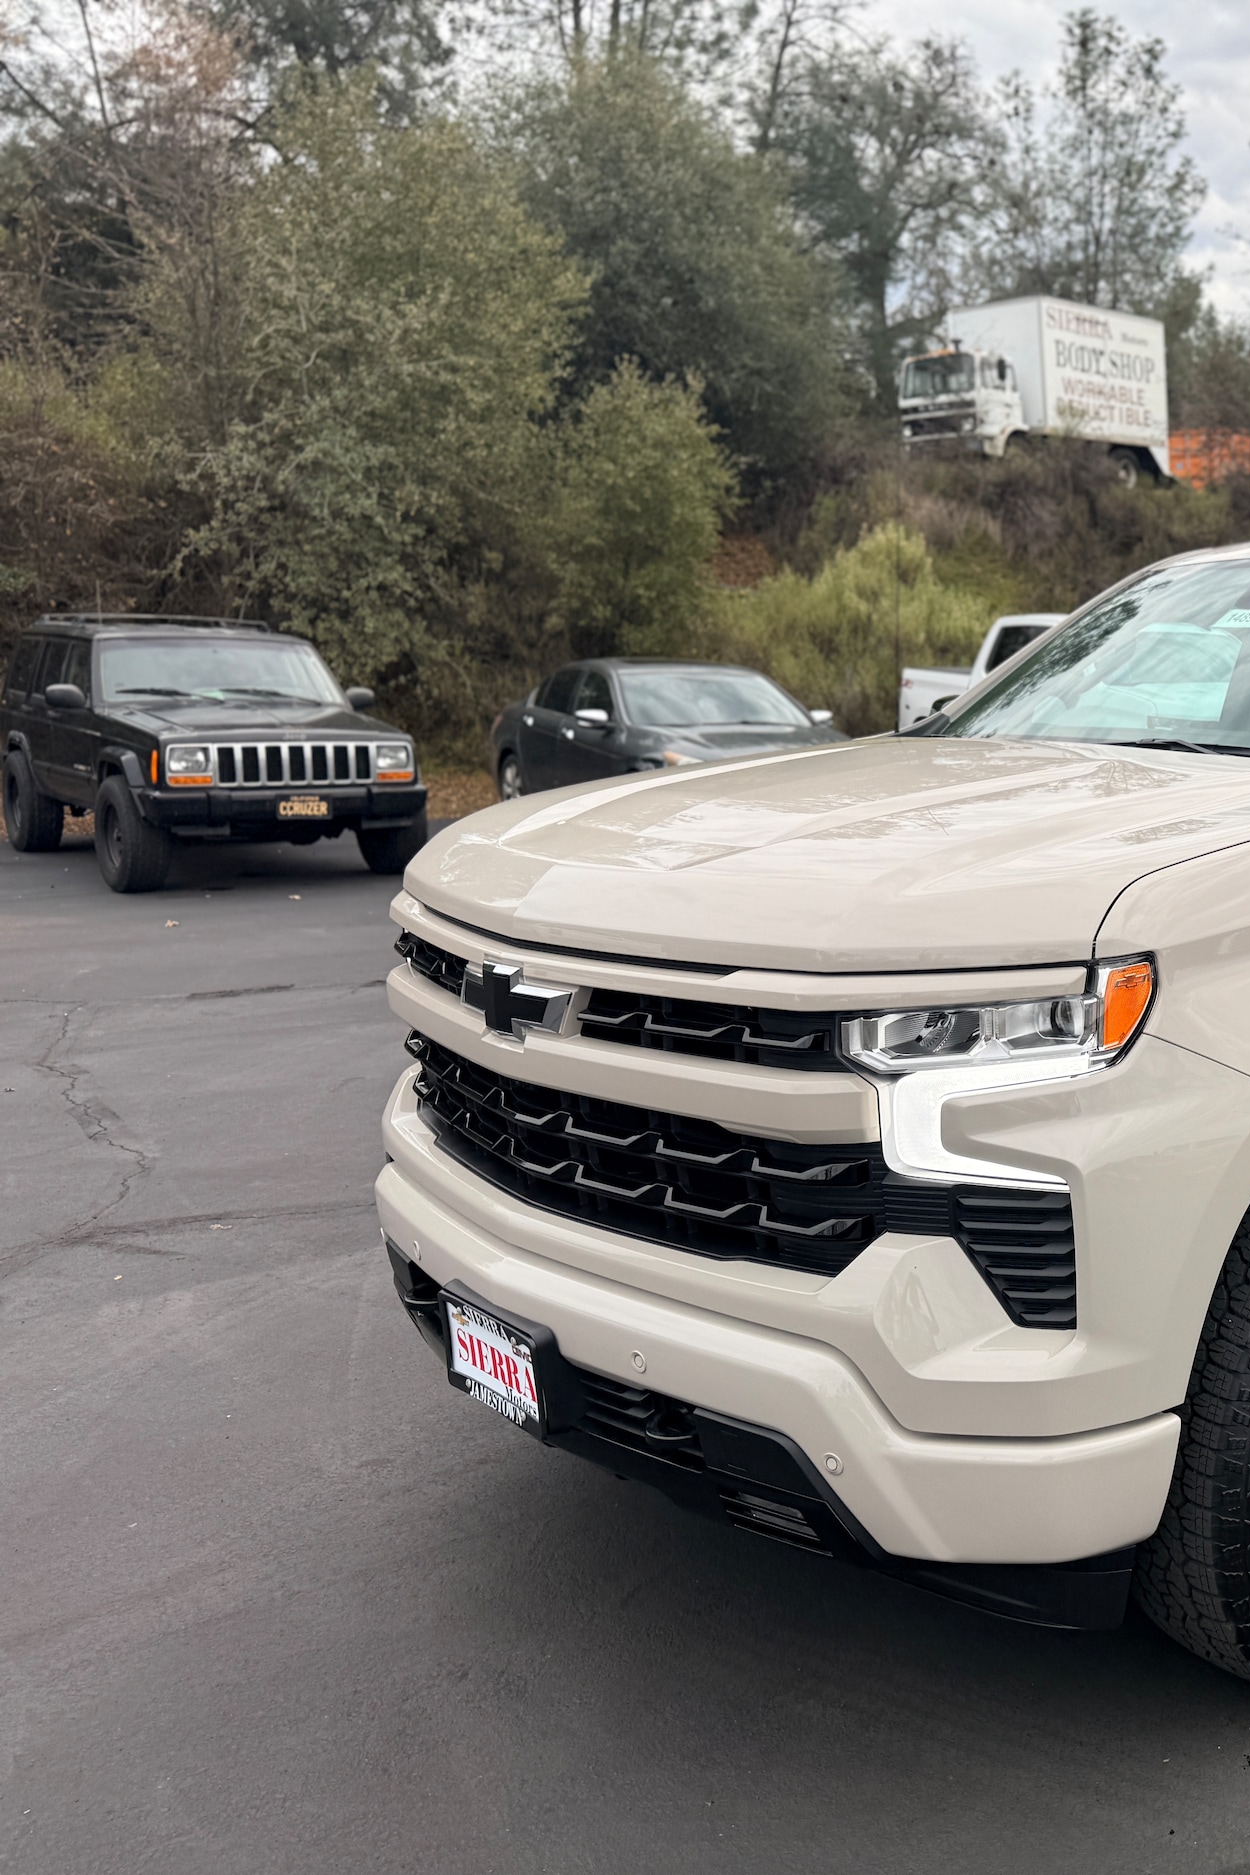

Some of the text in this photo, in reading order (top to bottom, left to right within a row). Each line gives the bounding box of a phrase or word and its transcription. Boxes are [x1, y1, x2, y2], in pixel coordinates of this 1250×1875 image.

[1054, 339, 1107, 379] BODY
[1108, 349, 1156, 384] SHOP
[462, 1305, 509, 1342] SIERRA
[456, 1327, 538, 1404] SIERRA
[469, 1379, 524, 1427] JAMESTOWN
[505, 1384, 538, 1418] Motors
